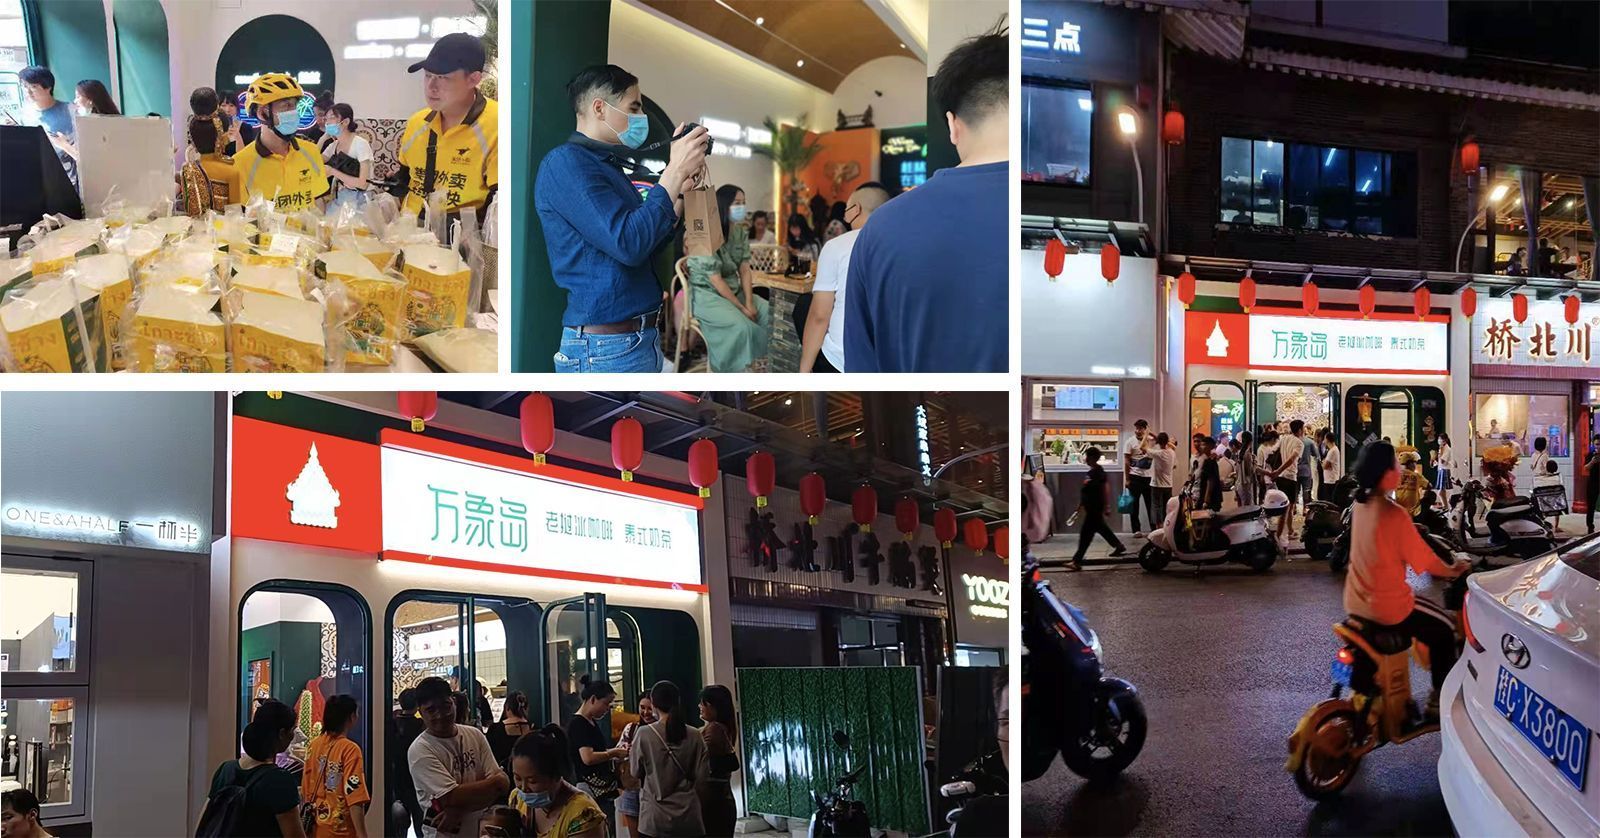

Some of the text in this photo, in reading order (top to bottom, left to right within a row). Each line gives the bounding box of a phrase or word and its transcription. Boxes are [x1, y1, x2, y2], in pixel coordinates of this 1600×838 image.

[1021, 17, 1082, 53] 三点
[1271, 328, 1329, 361] 万象岛
[1484, 316, 1592, 361] 桥北川
[6, 506, 198, 543] ONE&AHALF 一杯半
[427, 483, 673, 553] 万象岛 老挝冰咖啡 泰式奶茶
